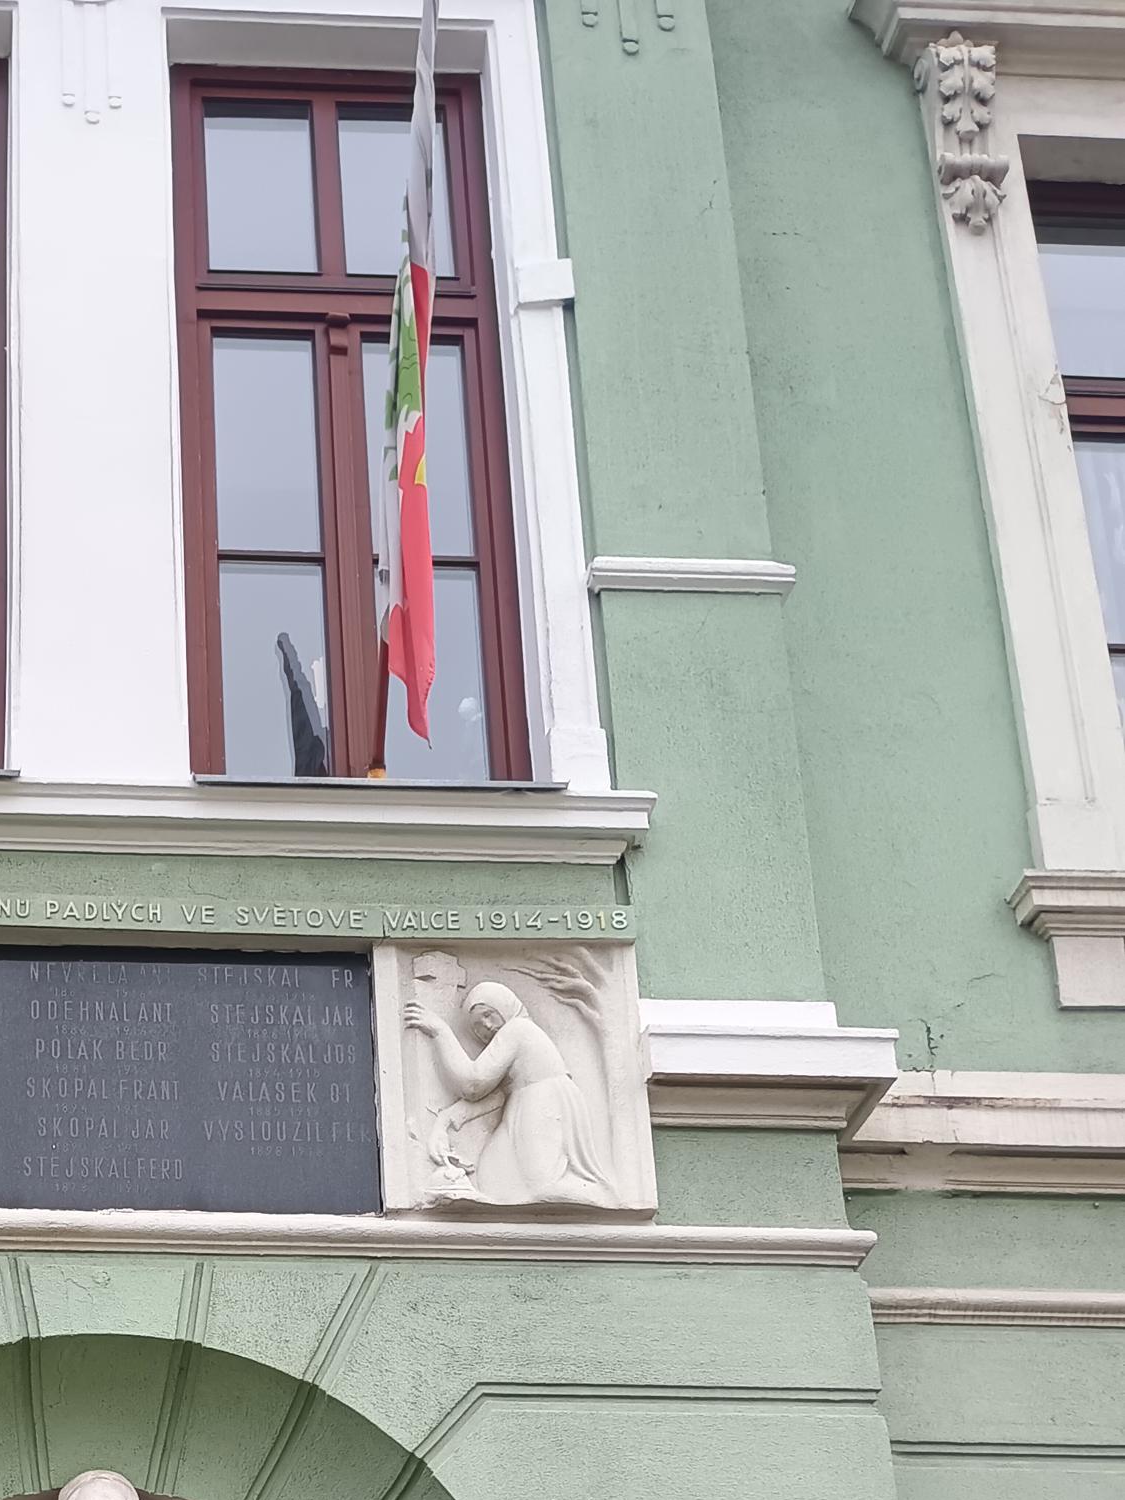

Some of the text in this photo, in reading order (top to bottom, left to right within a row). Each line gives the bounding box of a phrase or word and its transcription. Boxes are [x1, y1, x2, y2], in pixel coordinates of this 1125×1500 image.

[181, 904, 215, 924] VE
[475, 910, 628, 931] 1914-1918
[31, 999, 172, 1022] ODEHNAL ANT
[210, 1003, 354, 1026] STEJSKAL JAR
[116, 1040, 167, 1061] BEDR
[211, 1041, 356, 1064] STEJSKAL JOS
[27, 1077, 180, 1101] SKOPAL FRANT
[132, 1118, 169, 1139] JAR
[23, 1156, 182, 1180] STEJSKAL FERD
